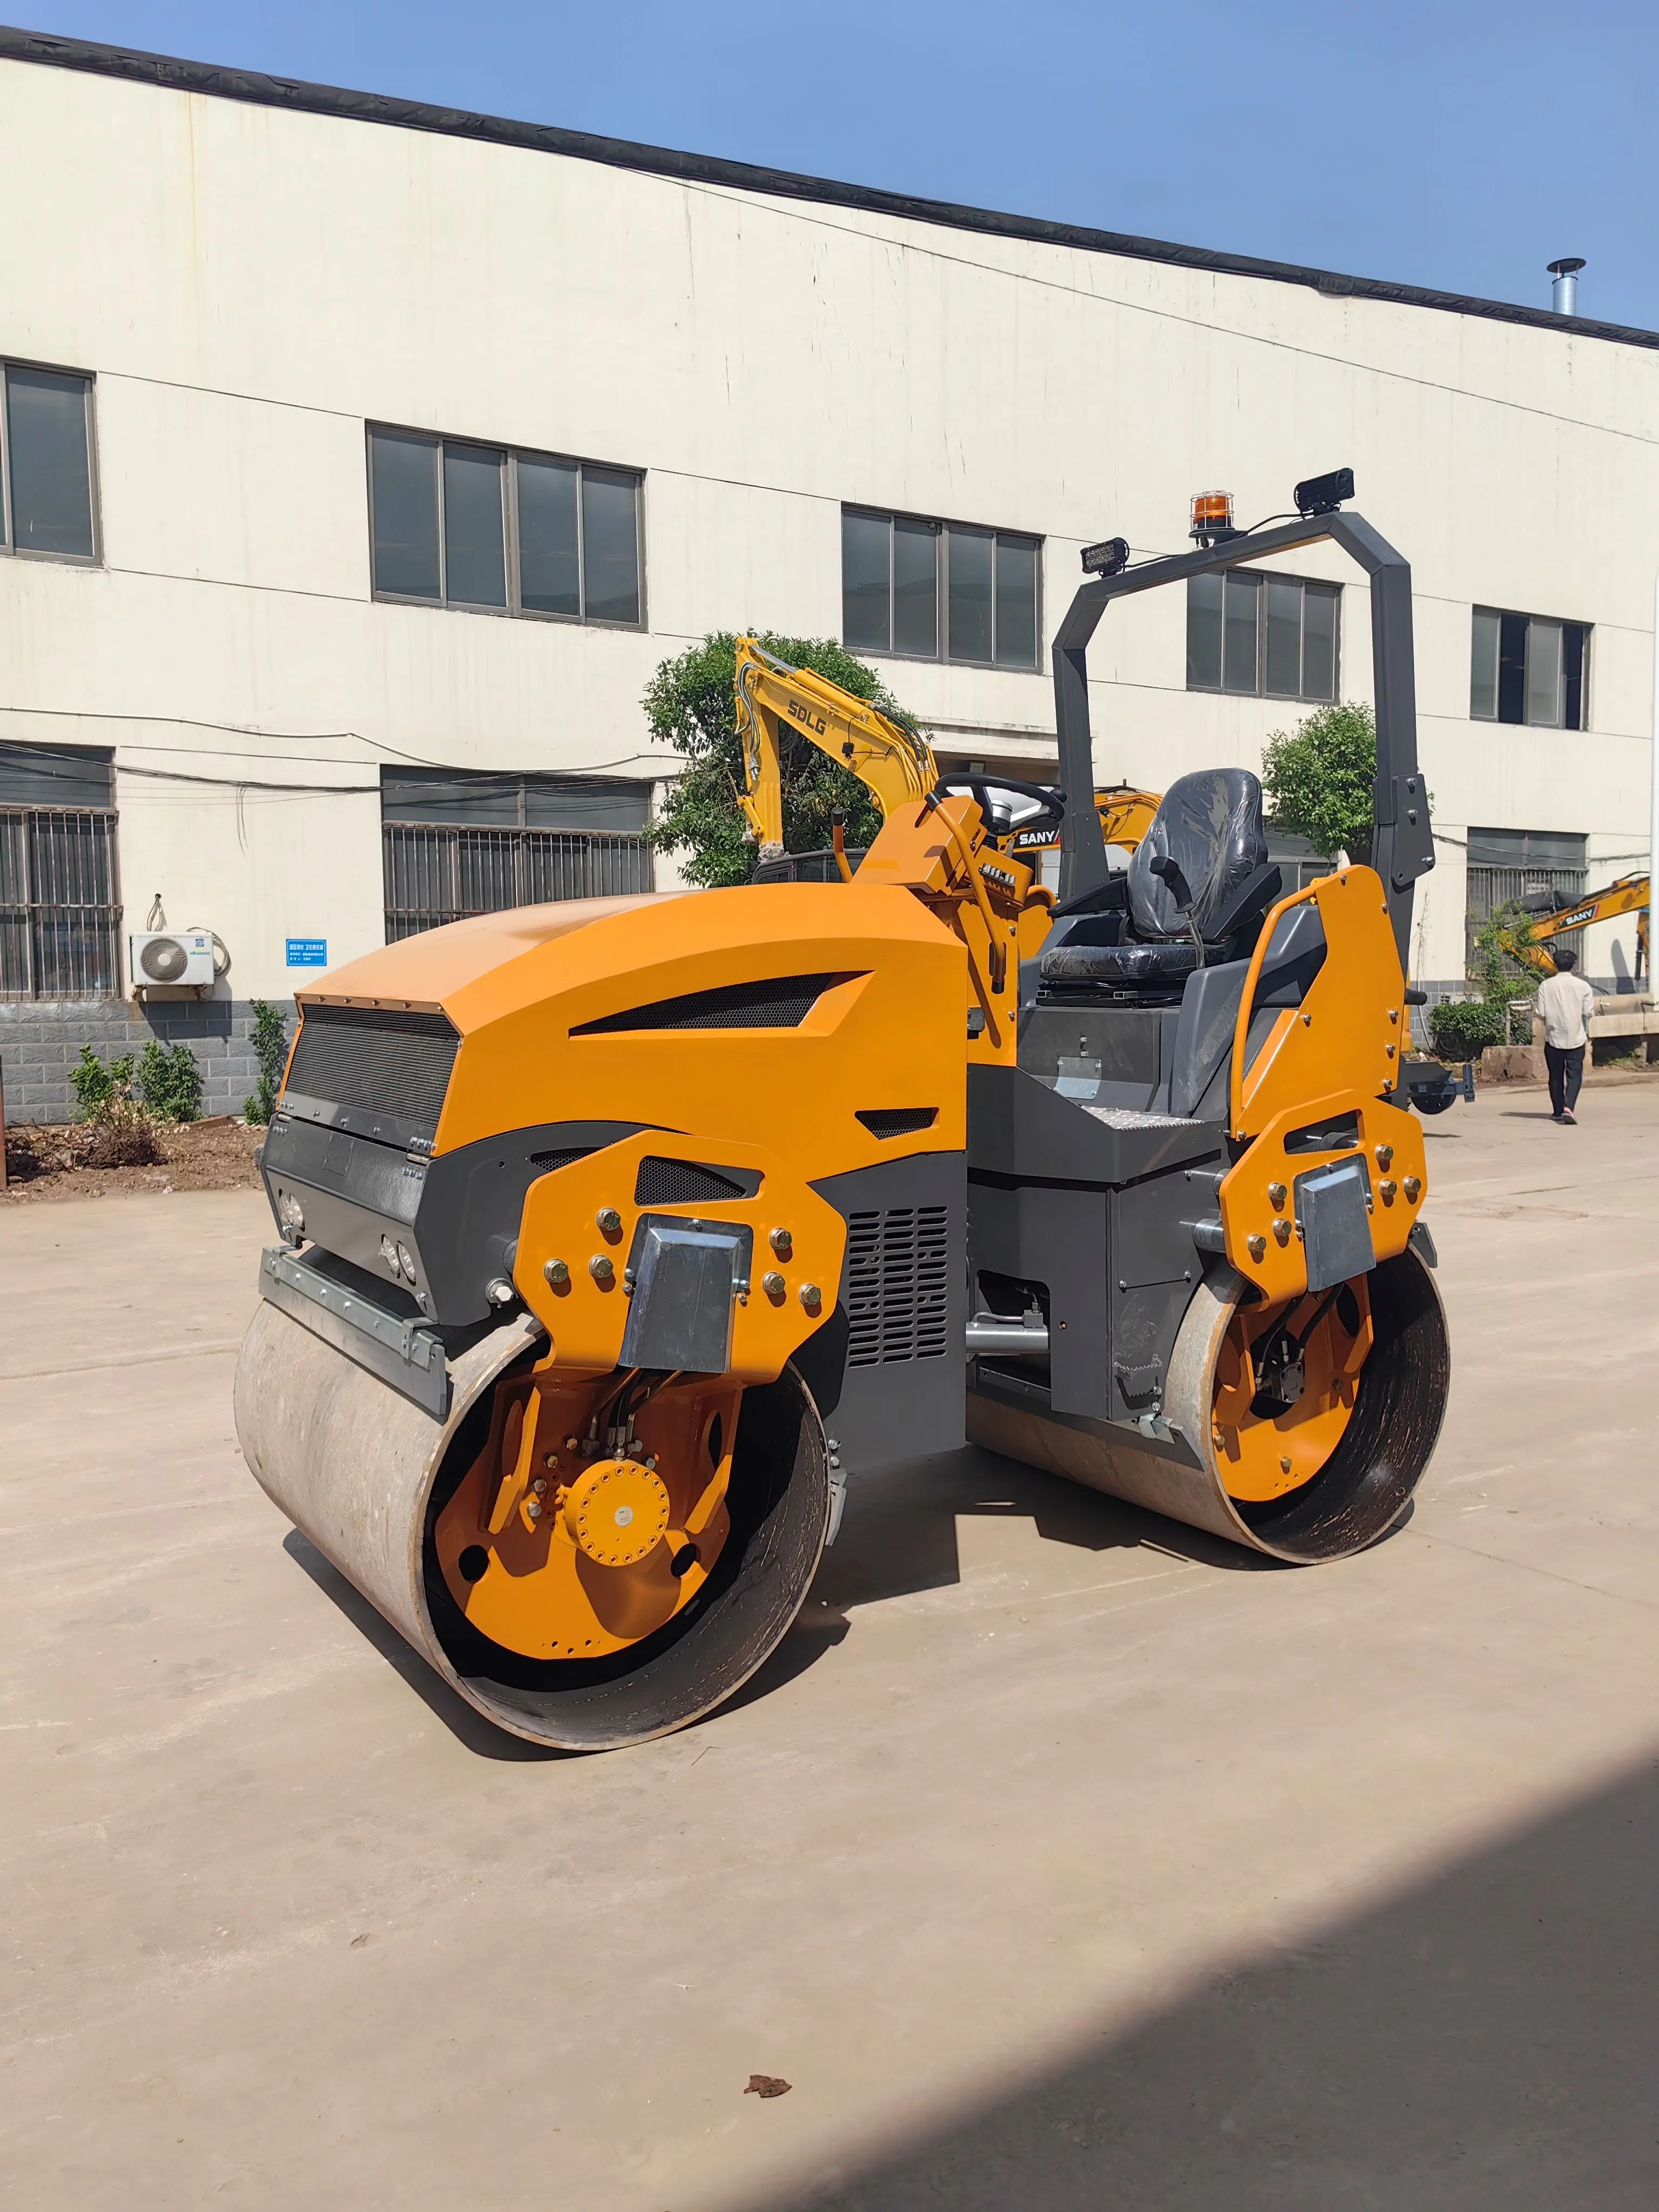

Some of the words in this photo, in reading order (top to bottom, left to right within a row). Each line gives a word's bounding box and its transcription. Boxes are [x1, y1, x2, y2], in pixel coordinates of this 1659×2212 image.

[788, 699, 827, 736] SDLG
[1020, 831, 1055, 845] SANY
[1566, 909, 1593, 925] SANY
